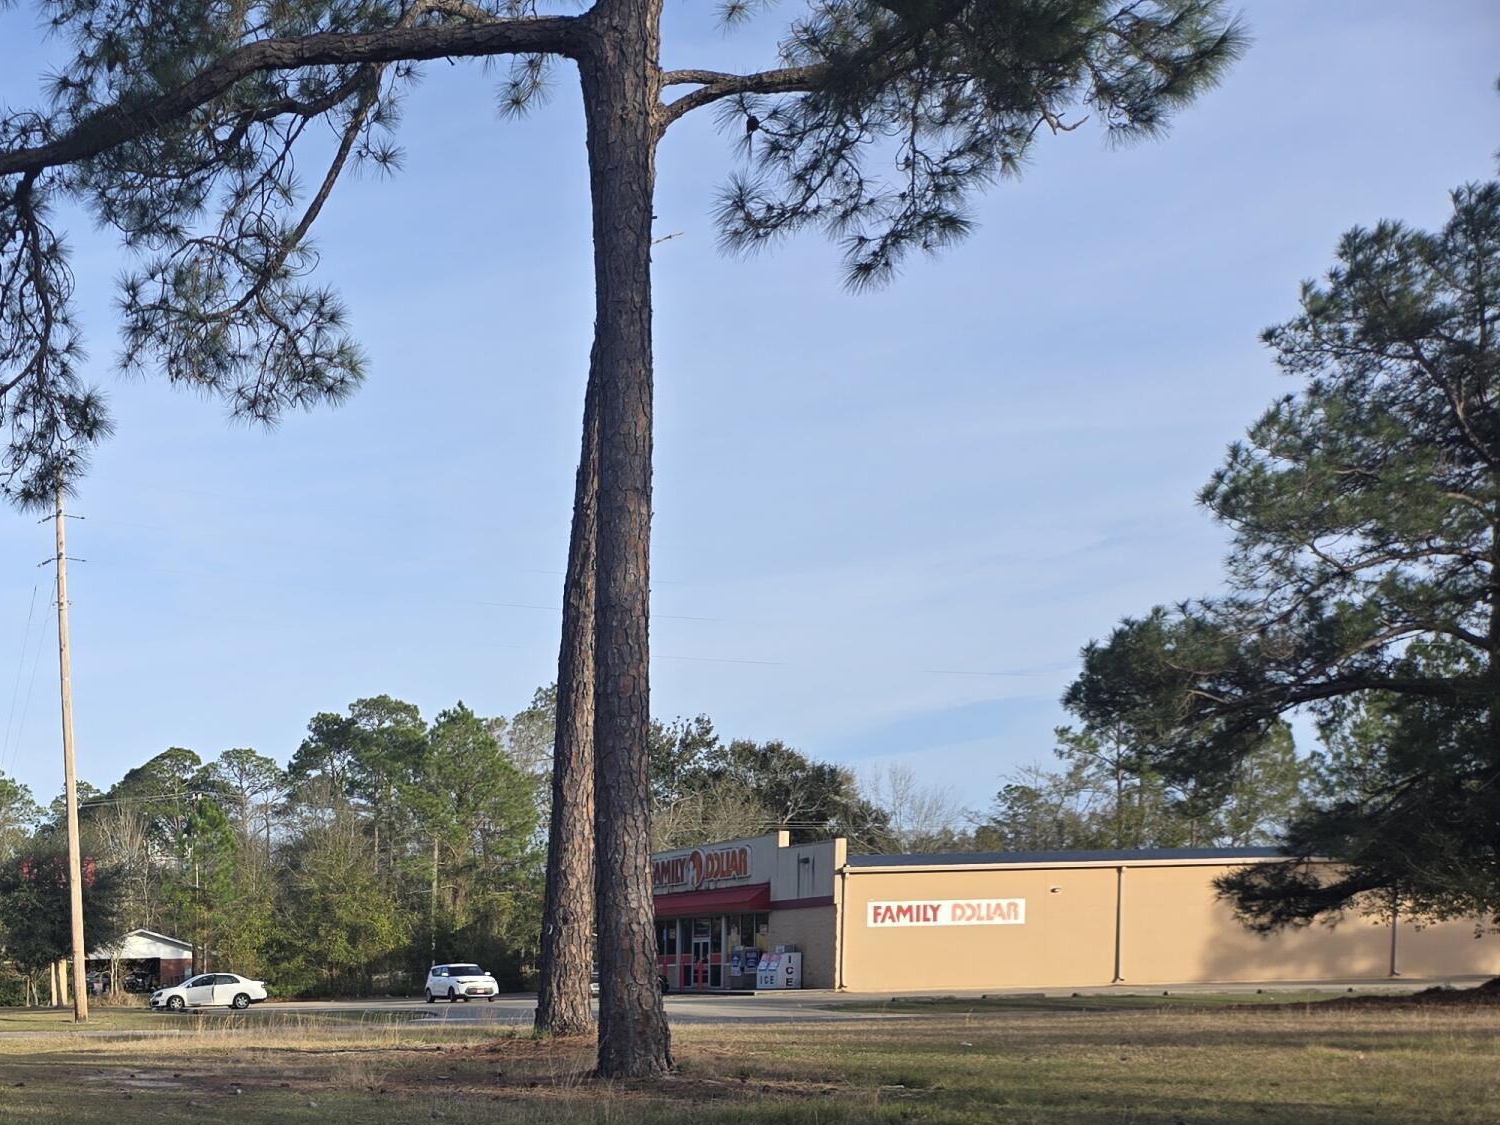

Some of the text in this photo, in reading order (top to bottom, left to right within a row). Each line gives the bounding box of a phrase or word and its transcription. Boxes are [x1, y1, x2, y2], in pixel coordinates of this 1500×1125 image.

[652, 848, 748, 885] AMILY DOLLAR
[873, 902, 1019, 923] FAMILY DOLLAR
[760, 975, 774, 984] ICE
[786, 955, 794, 986] ICE
